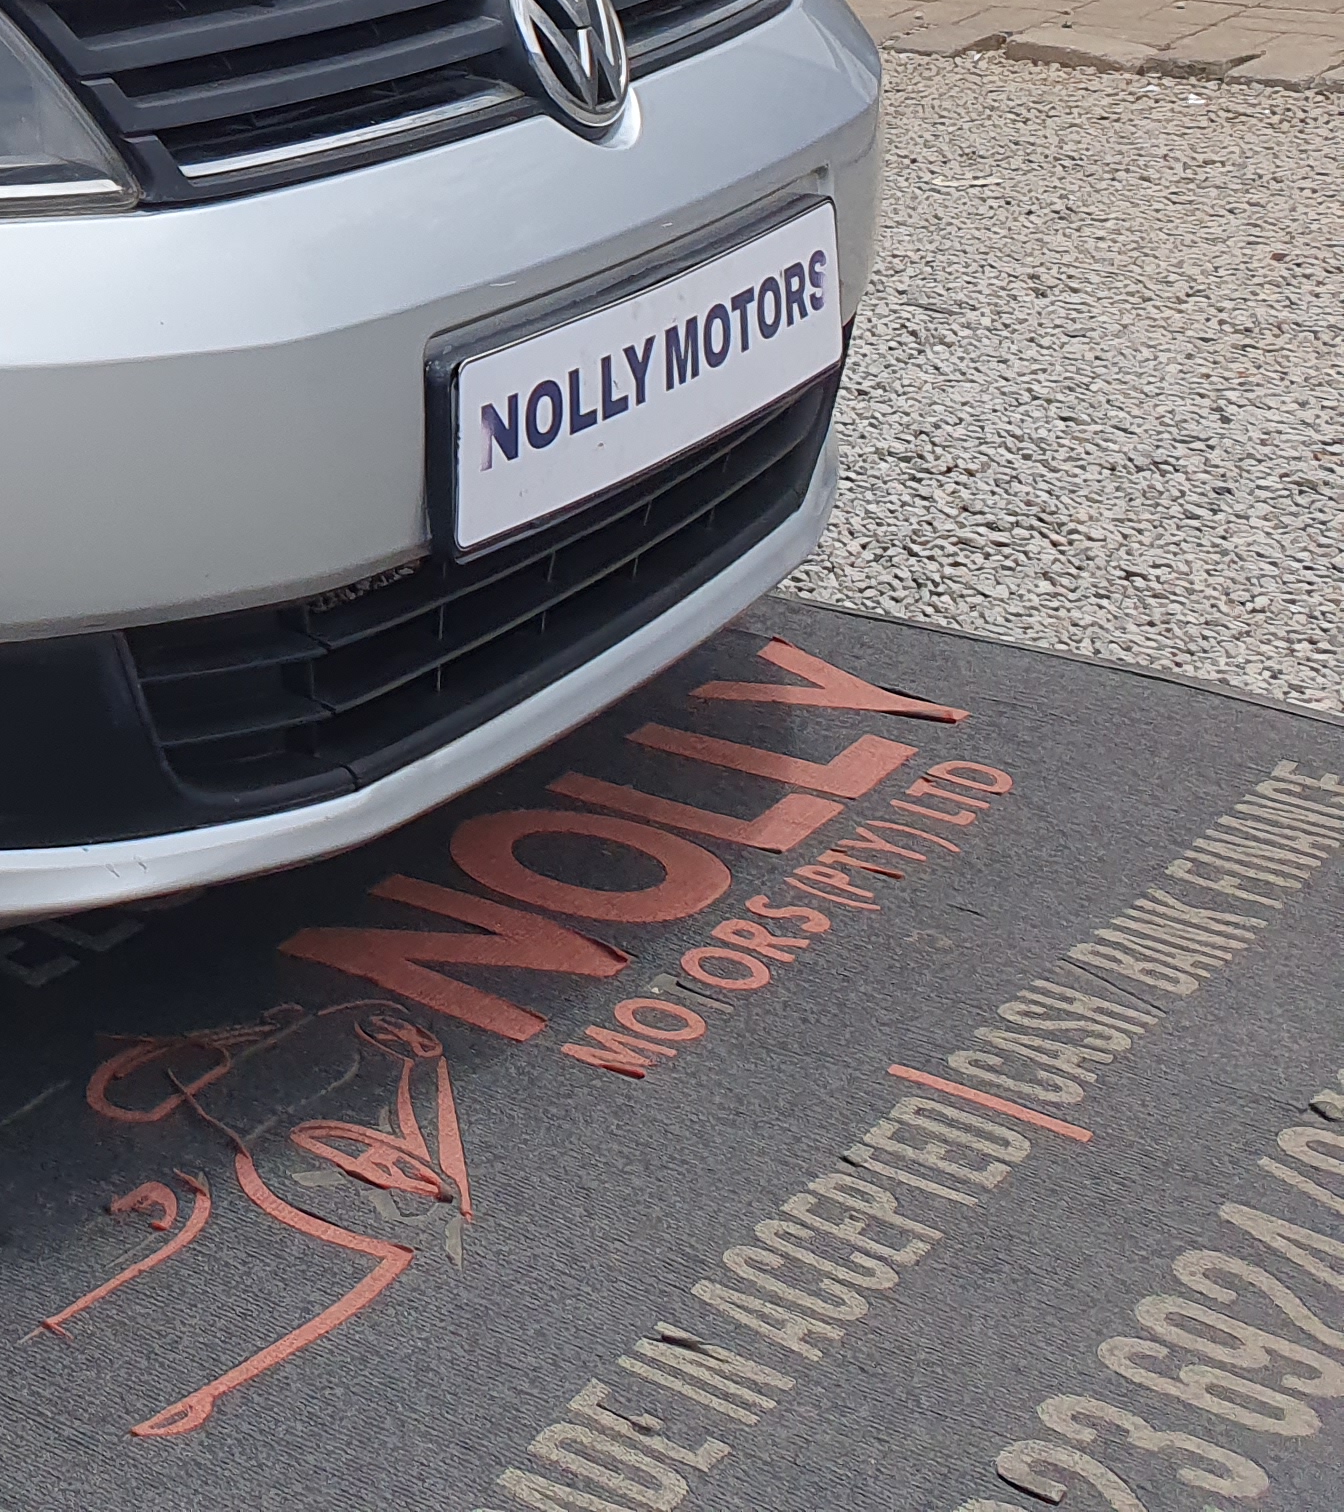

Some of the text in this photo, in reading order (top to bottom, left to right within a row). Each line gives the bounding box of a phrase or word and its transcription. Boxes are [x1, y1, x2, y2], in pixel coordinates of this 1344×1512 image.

[480, 249, 827, 472] NOLLY MOTORS
[279, 636, 971, 1042] NOLLY
[561, 760, 1013, 1079] MOTORS (PTY) LTD
[690, 1096, 1031, 1362] ACCEPTED
[617, 1320, 797, 1426] IN
